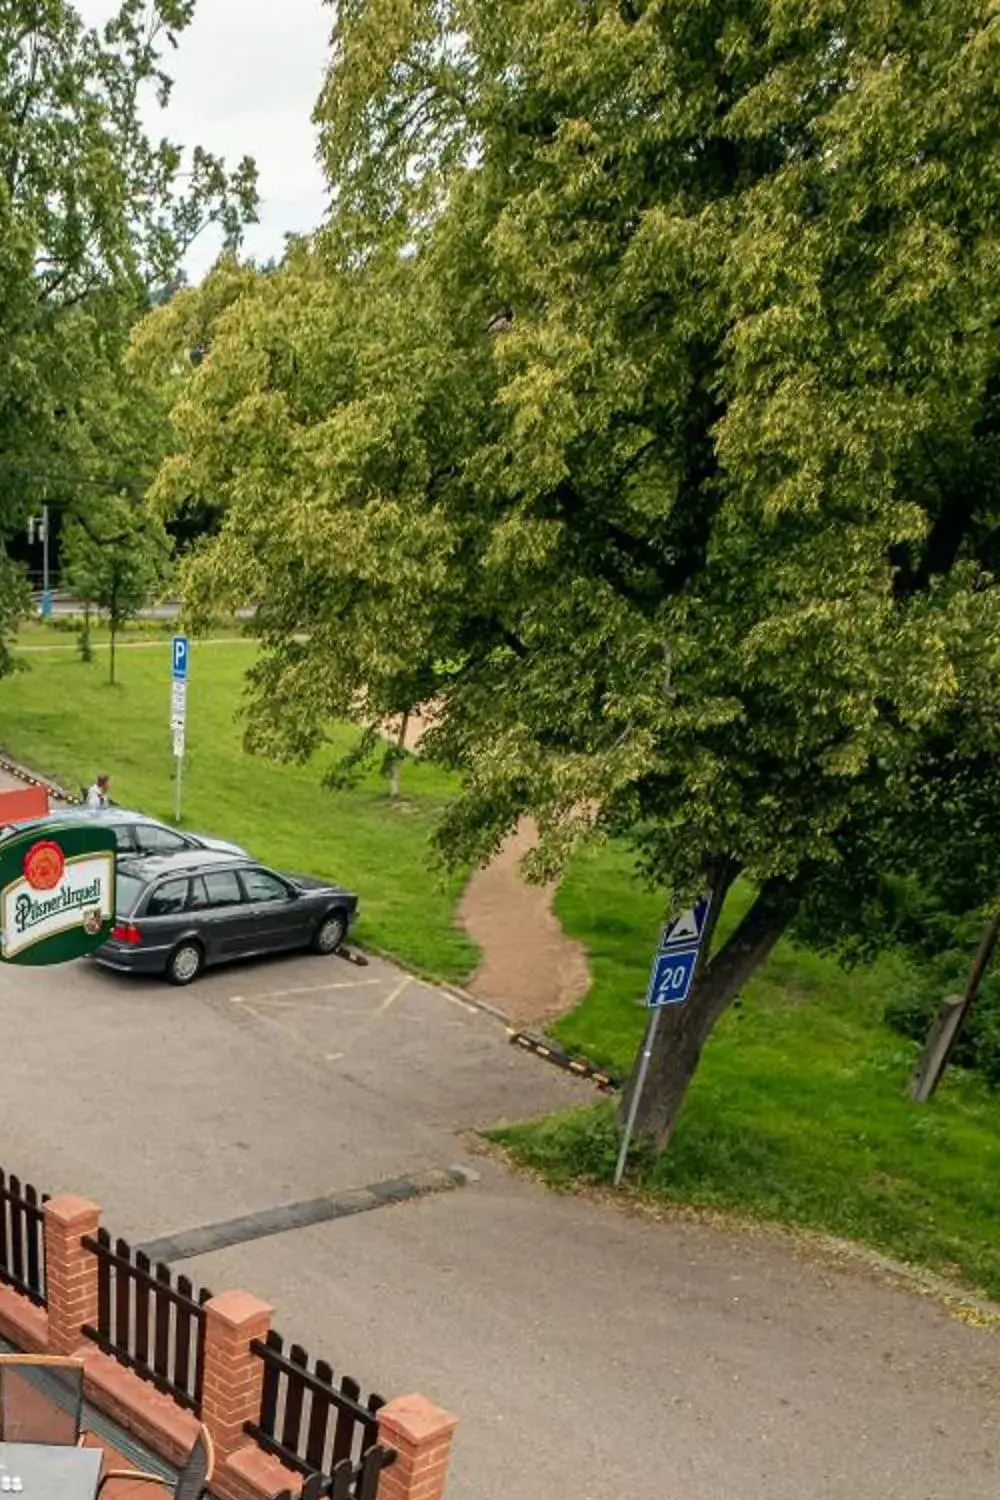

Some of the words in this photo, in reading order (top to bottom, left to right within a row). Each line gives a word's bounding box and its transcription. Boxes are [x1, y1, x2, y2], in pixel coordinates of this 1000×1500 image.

[175, 641, 185, 667] P
[15, 893, 62, 933] Pilsner
[60, 877, 101, 911] Urquell
[659, 965, 685, 991] 20
